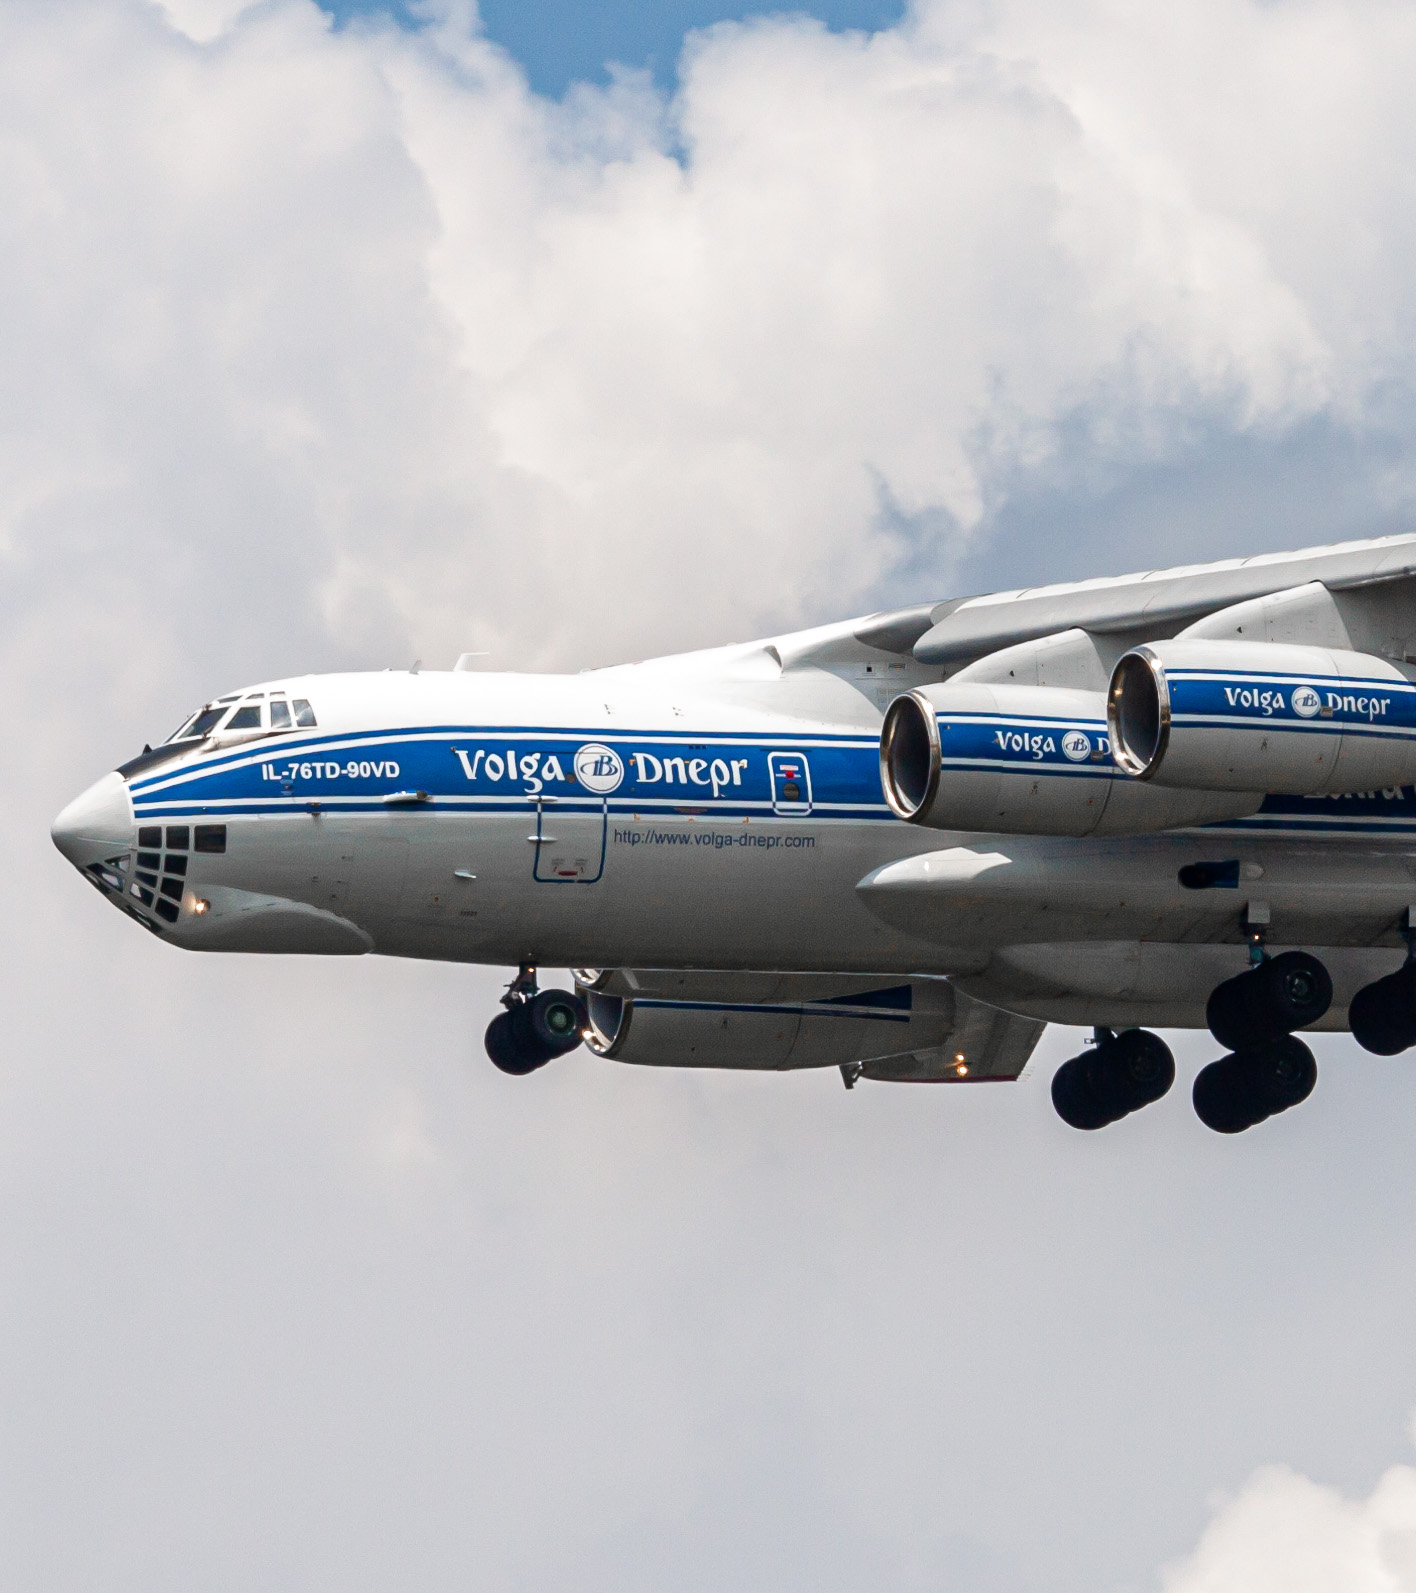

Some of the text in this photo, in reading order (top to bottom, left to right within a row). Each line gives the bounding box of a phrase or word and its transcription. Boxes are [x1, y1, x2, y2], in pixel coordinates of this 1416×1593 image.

[1224, 687, 1286, 716] Volga
[1326, 692, 1391, 722] Dnepr
[994, 730, 1057, 760] Volga
[261, 761, 400, 781] IL-76TD-90VD
[455, 750, 566, 794] Volga
[632, 752, 748, 798] Dnepr
[613, 829, 816, 849] http://www.volga-dnepr.com
